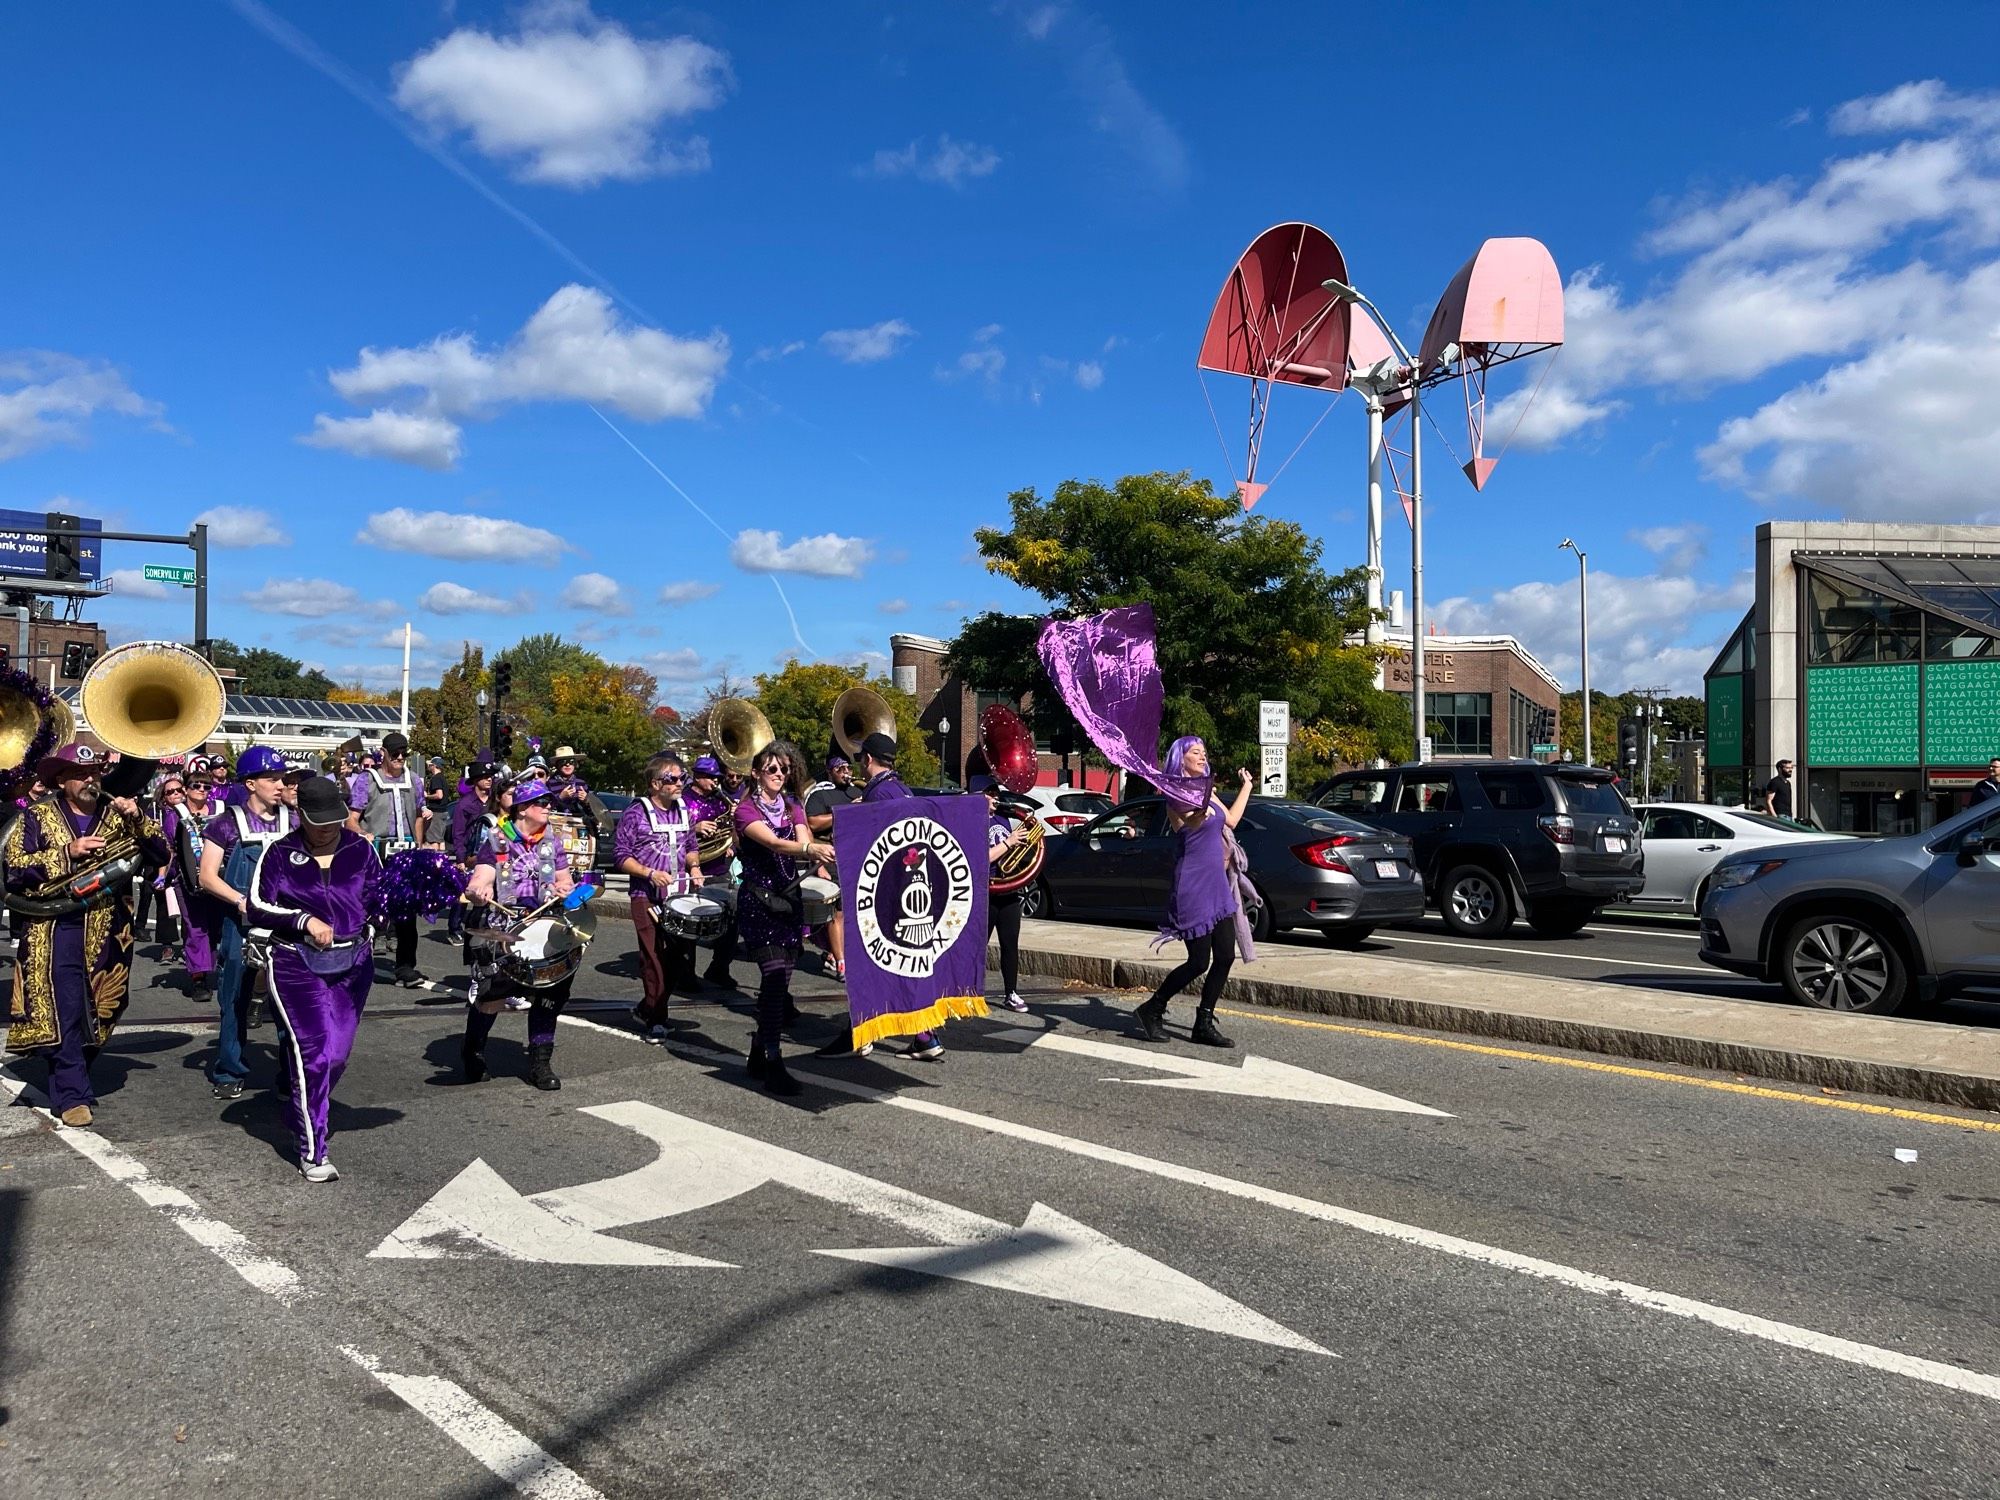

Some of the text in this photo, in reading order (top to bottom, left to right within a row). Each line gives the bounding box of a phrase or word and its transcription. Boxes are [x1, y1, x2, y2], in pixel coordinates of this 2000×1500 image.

[18, 543, 40, 553] you
[145, 568, 194, 581] SOMERVILLE AVE
[1393, 669, 1456, 684] SQARE
[1275, 707, 1286, 715] LANE
[1267, 719, 1281, 727] MUST
[1265, 757, 1283, 765] STOP
[1270, 784, 1284, 792] RED
[858, 820, 970, 911] BLOWCOMOTION
[867, 937, 930, 972] AUSTIN
